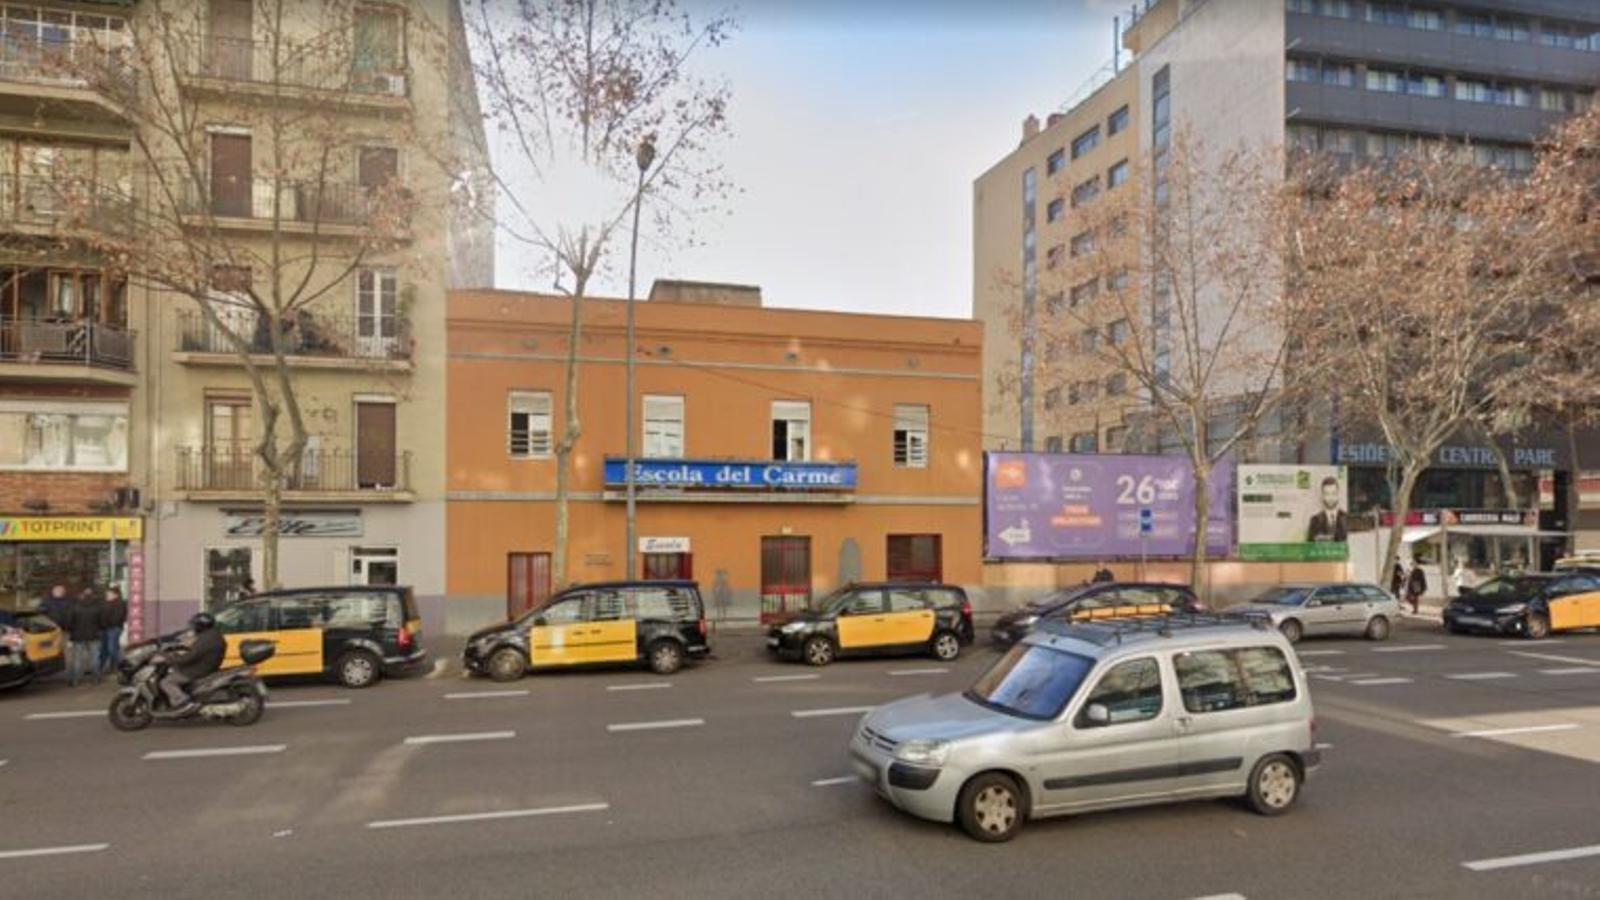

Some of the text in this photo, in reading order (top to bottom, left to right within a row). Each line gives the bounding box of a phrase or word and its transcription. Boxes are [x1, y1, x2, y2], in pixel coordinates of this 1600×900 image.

[1513, 448, 1558, 465] PARC
[624, 464, 843, 484] Escola del Carme
[1115, 474, 1156, 504] 26
[20, 519, 105, 533] TOTPRINT
